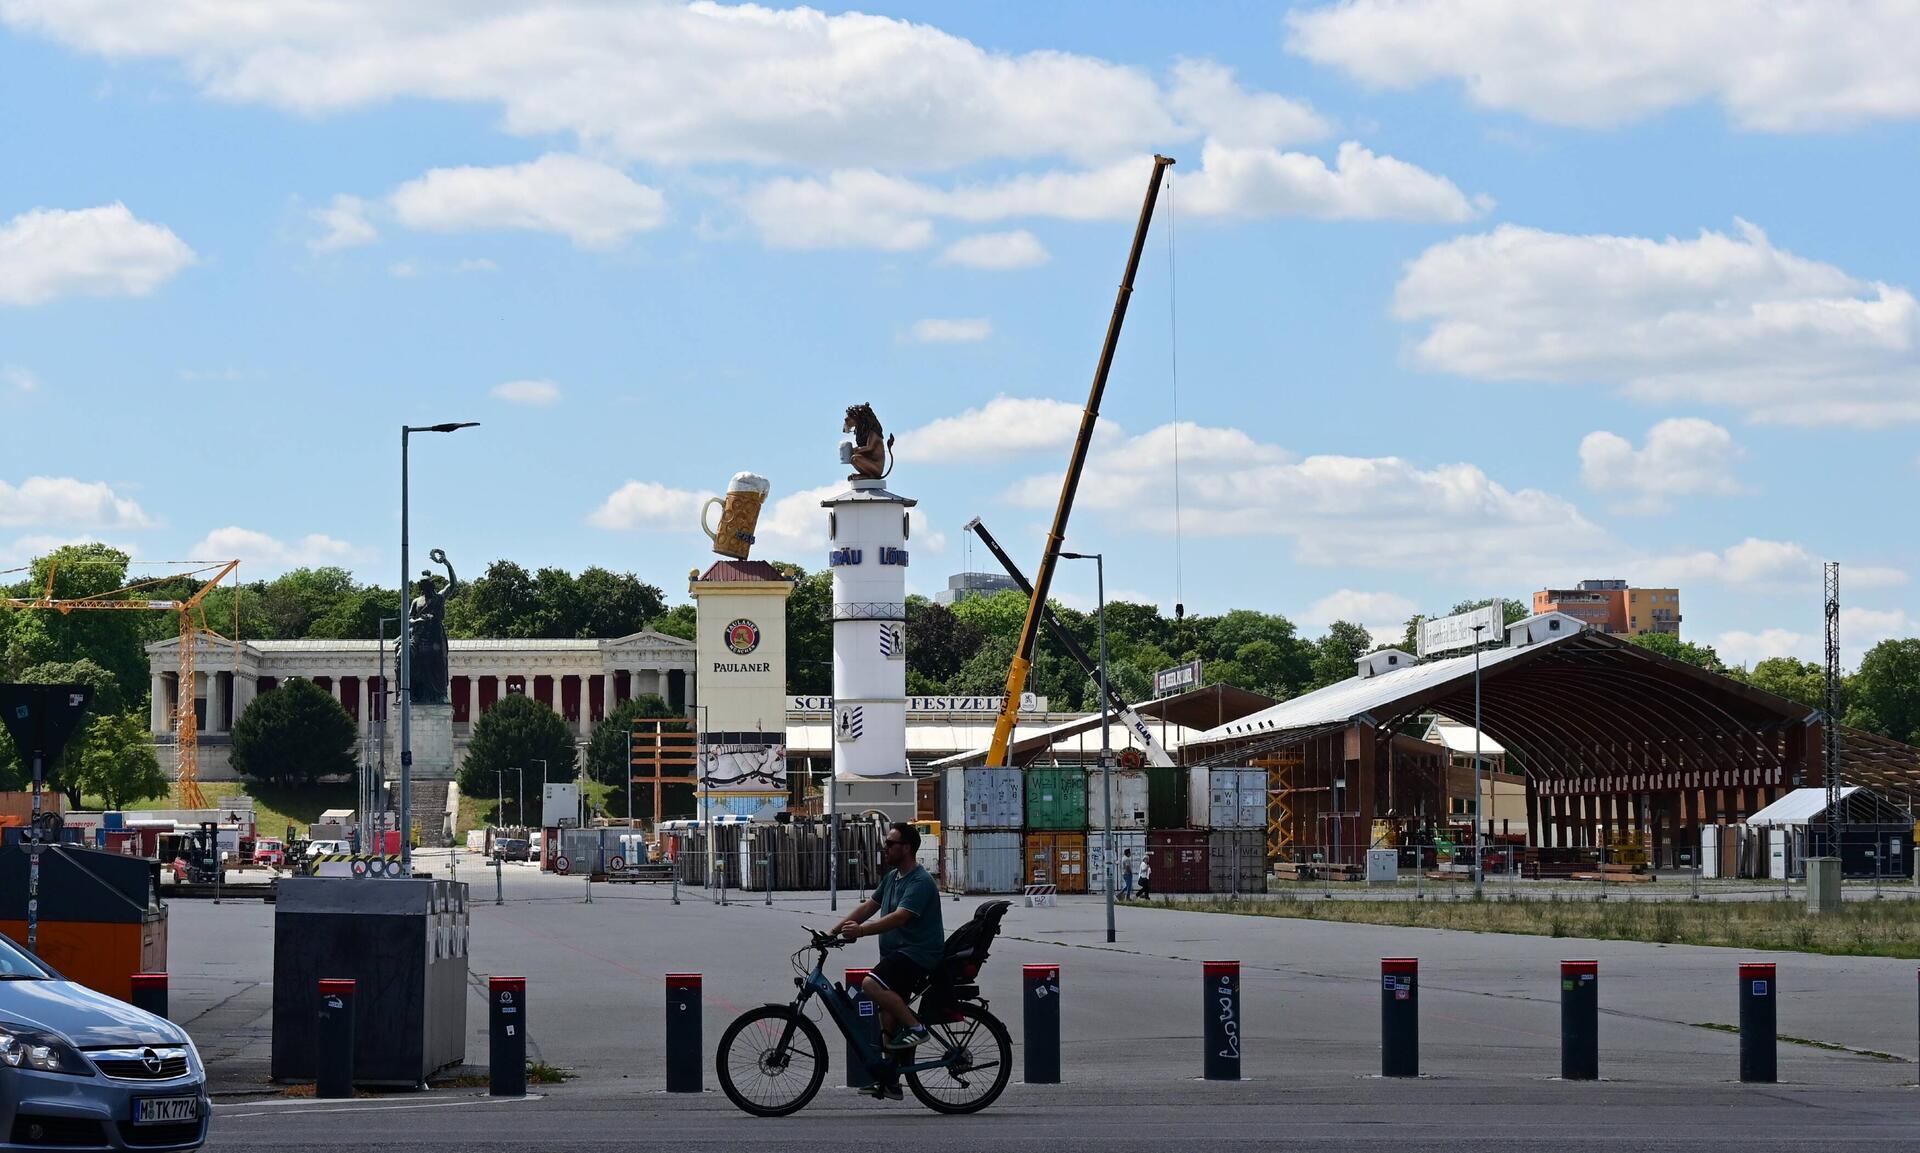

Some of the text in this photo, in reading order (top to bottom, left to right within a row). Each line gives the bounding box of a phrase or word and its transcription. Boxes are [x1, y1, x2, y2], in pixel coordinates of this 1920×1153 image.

[726, 620, 758, 633] PAULANER
[713, 662, 770, 673] PAULANER
[794, 696, 834, 710] SCH
[1000, 690, 1012, 716] KLAR
[1135, 721, 1152, 741] KLAR
